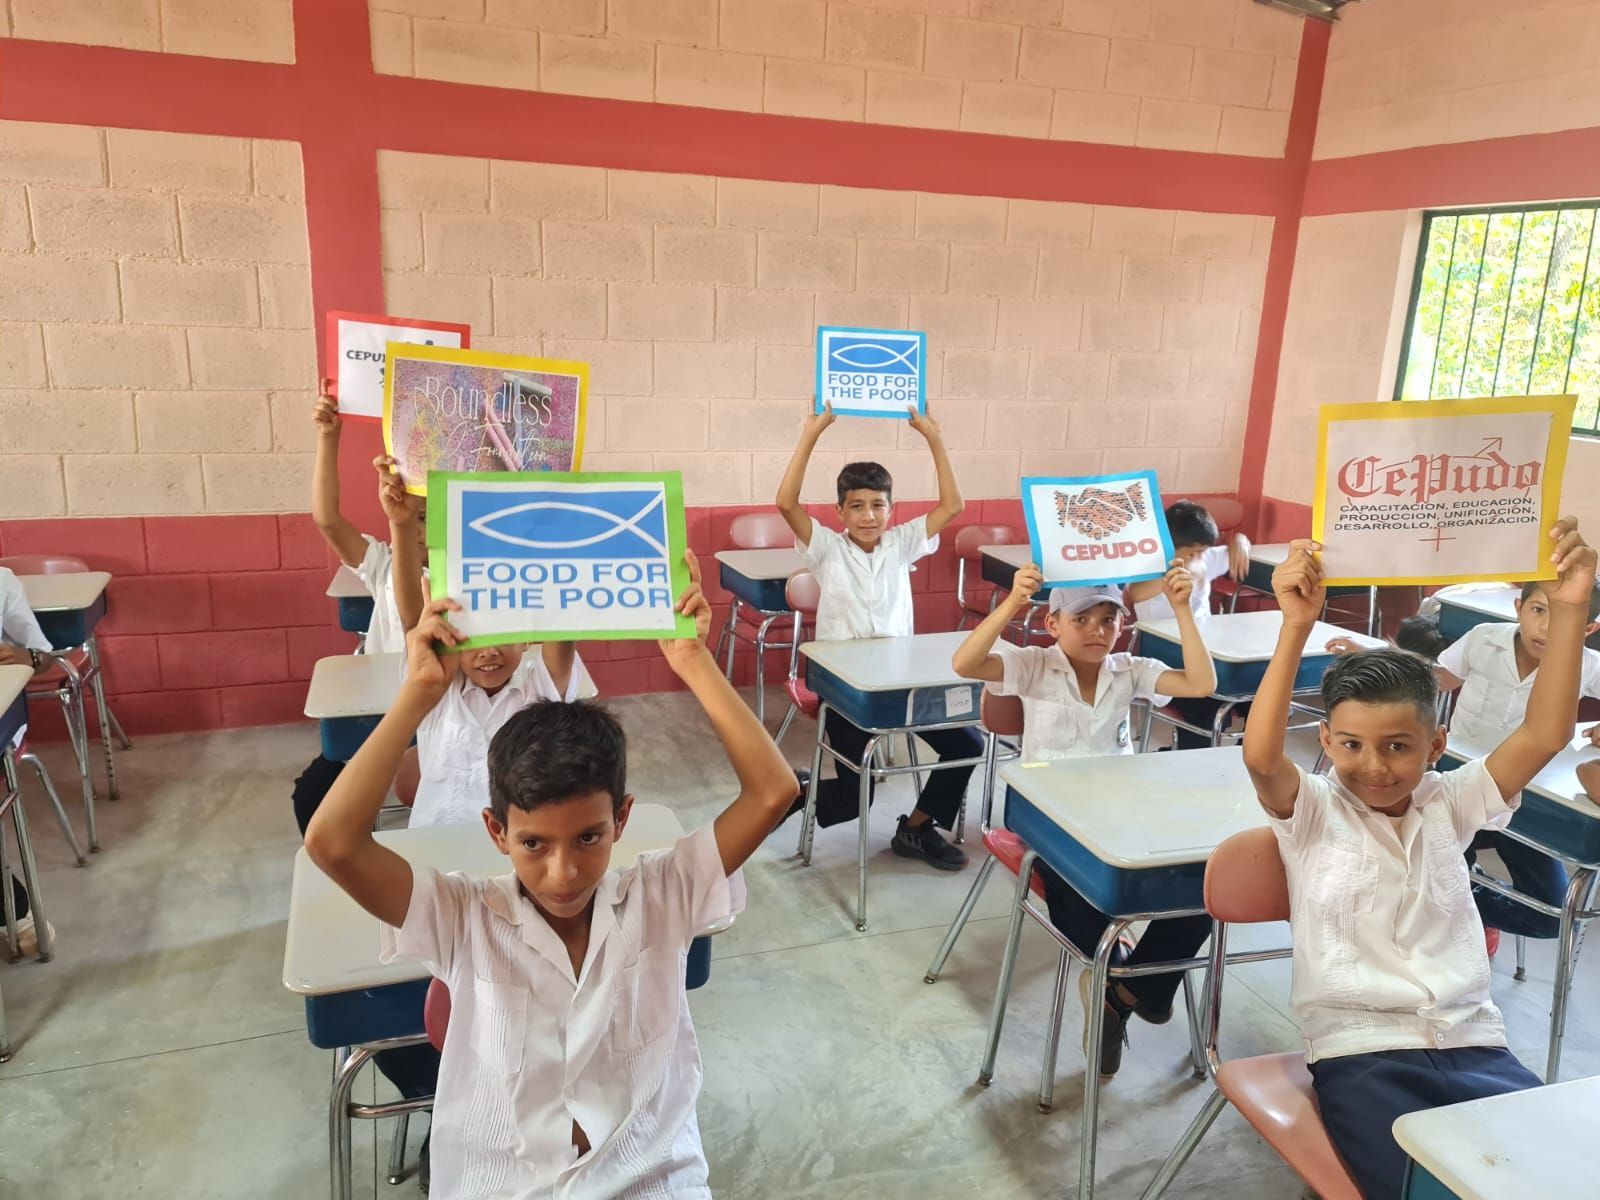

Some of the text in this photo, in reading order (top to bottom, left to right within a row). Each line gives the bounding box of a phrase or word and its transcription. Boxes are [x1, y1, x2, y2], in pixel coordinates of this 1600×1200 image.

[346, 349, 386, 362] CEPU
[828, 373, 918, 388] FOOD FOR
[415, 376, 552, 427] Boundless
[828, 386, 918, 401] THE POOR
[1061, 538, 1158, 561] CEPUDO
[462, 562, 668, 584] FOOD FOR
[462, 587, 671, 611] THE POOR
